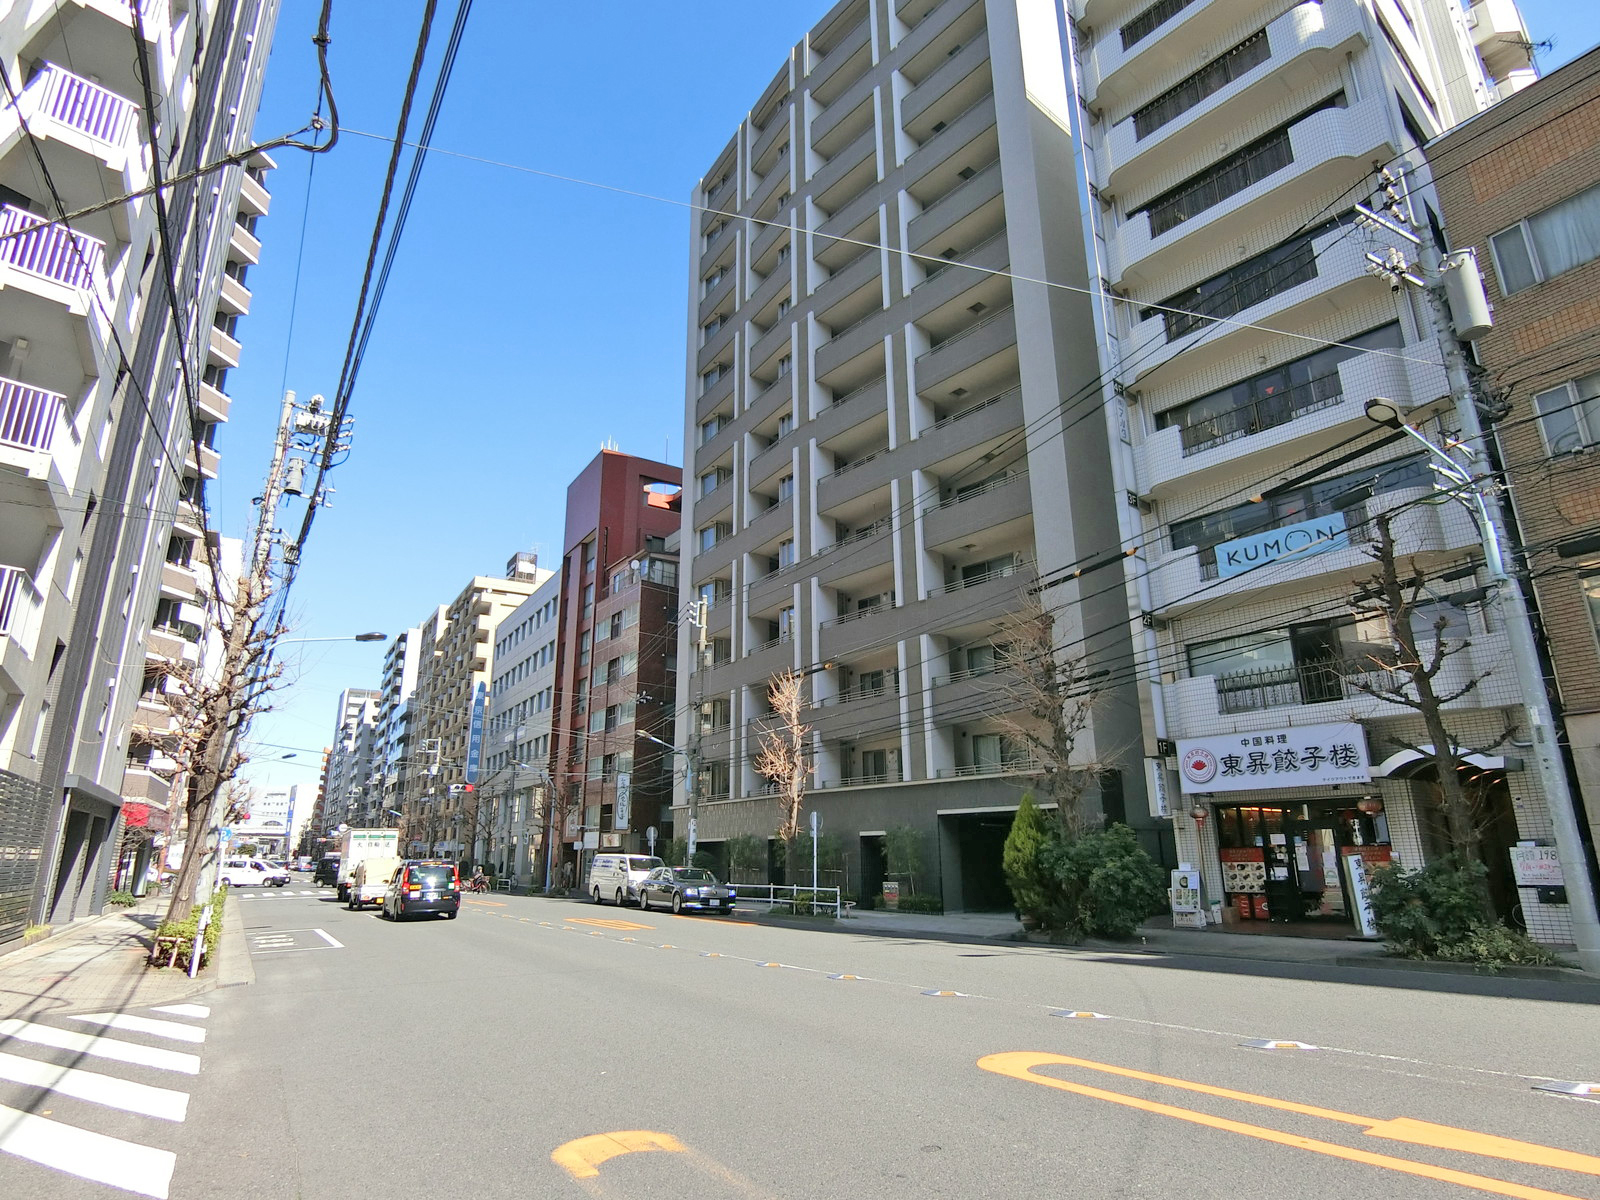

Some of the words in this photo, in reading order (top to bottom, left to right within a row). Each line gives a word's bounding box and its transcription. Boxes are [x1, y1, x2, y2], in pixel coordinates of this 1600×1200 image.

[1114, 383, 1123, 393] 4F
[1127, 493, 1136, 505] 3F
[1227, 526, 1335, 566] KUMON
[1142, 613, 1152, 626] 2F
[469, 691, 485, 773] 東京信用金庫
[1240, 734, 1288, 747] 中国料理
[1158, 742, 1168, 753] 1F
[1221, 744, 1358, 775] 東昇餃子楼
